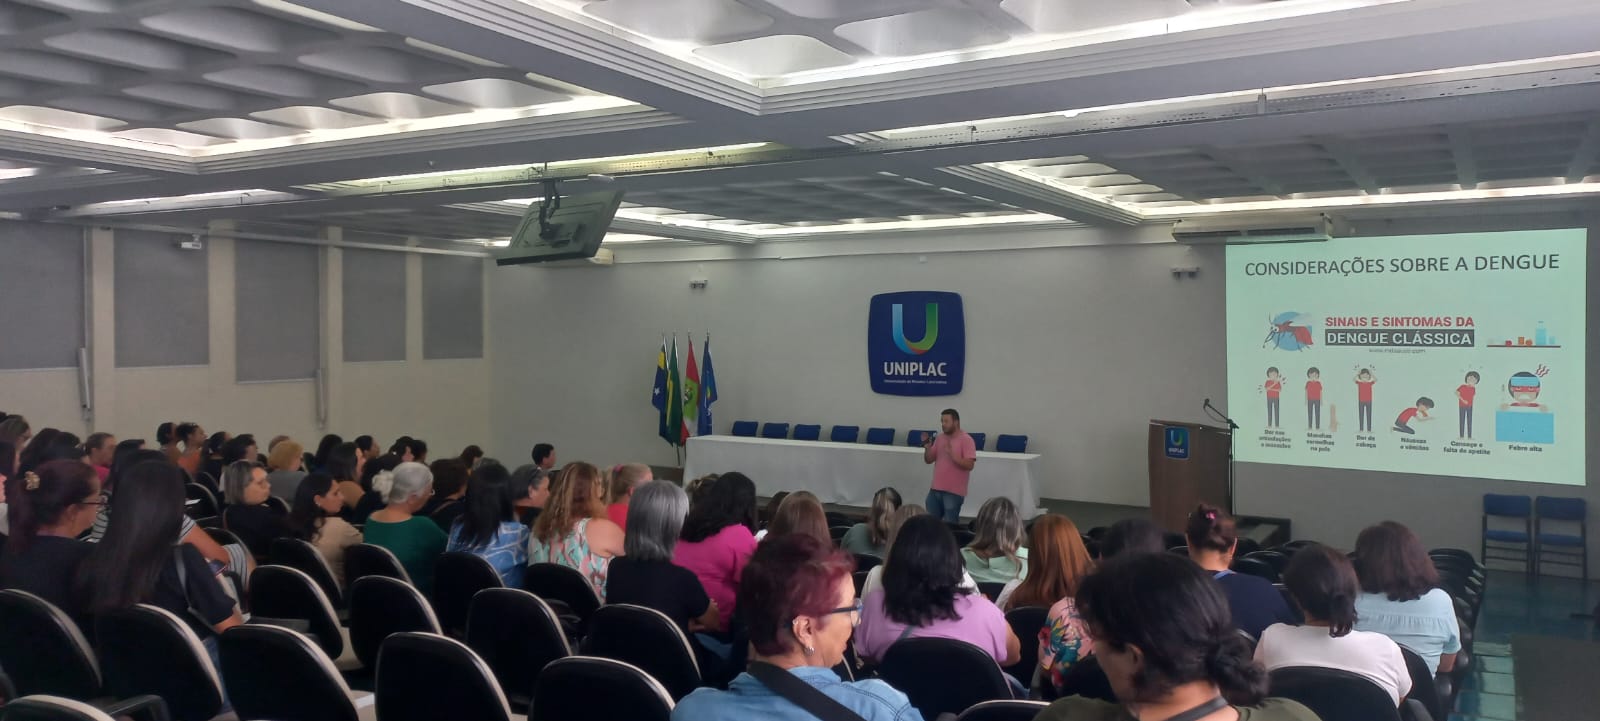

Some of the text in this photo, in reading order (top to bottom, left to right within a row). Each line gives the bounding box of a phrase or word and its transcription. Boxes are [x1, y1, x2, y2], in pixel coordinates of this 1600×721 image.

[1245, 254, 1560, 277] CONSIDERAÇÕES SOBRE A DENGUE
[1325, 316, 1475, 327] SINAIS E SINTOMAS DA
[1326, 330, 1472, 345] DENGUE CLÁSSICA
[883, 361, 948, 377] UNIPLAC
[1468, 448, 1491, 456] apetite
[1508, 444, 1528, 452] Febre
